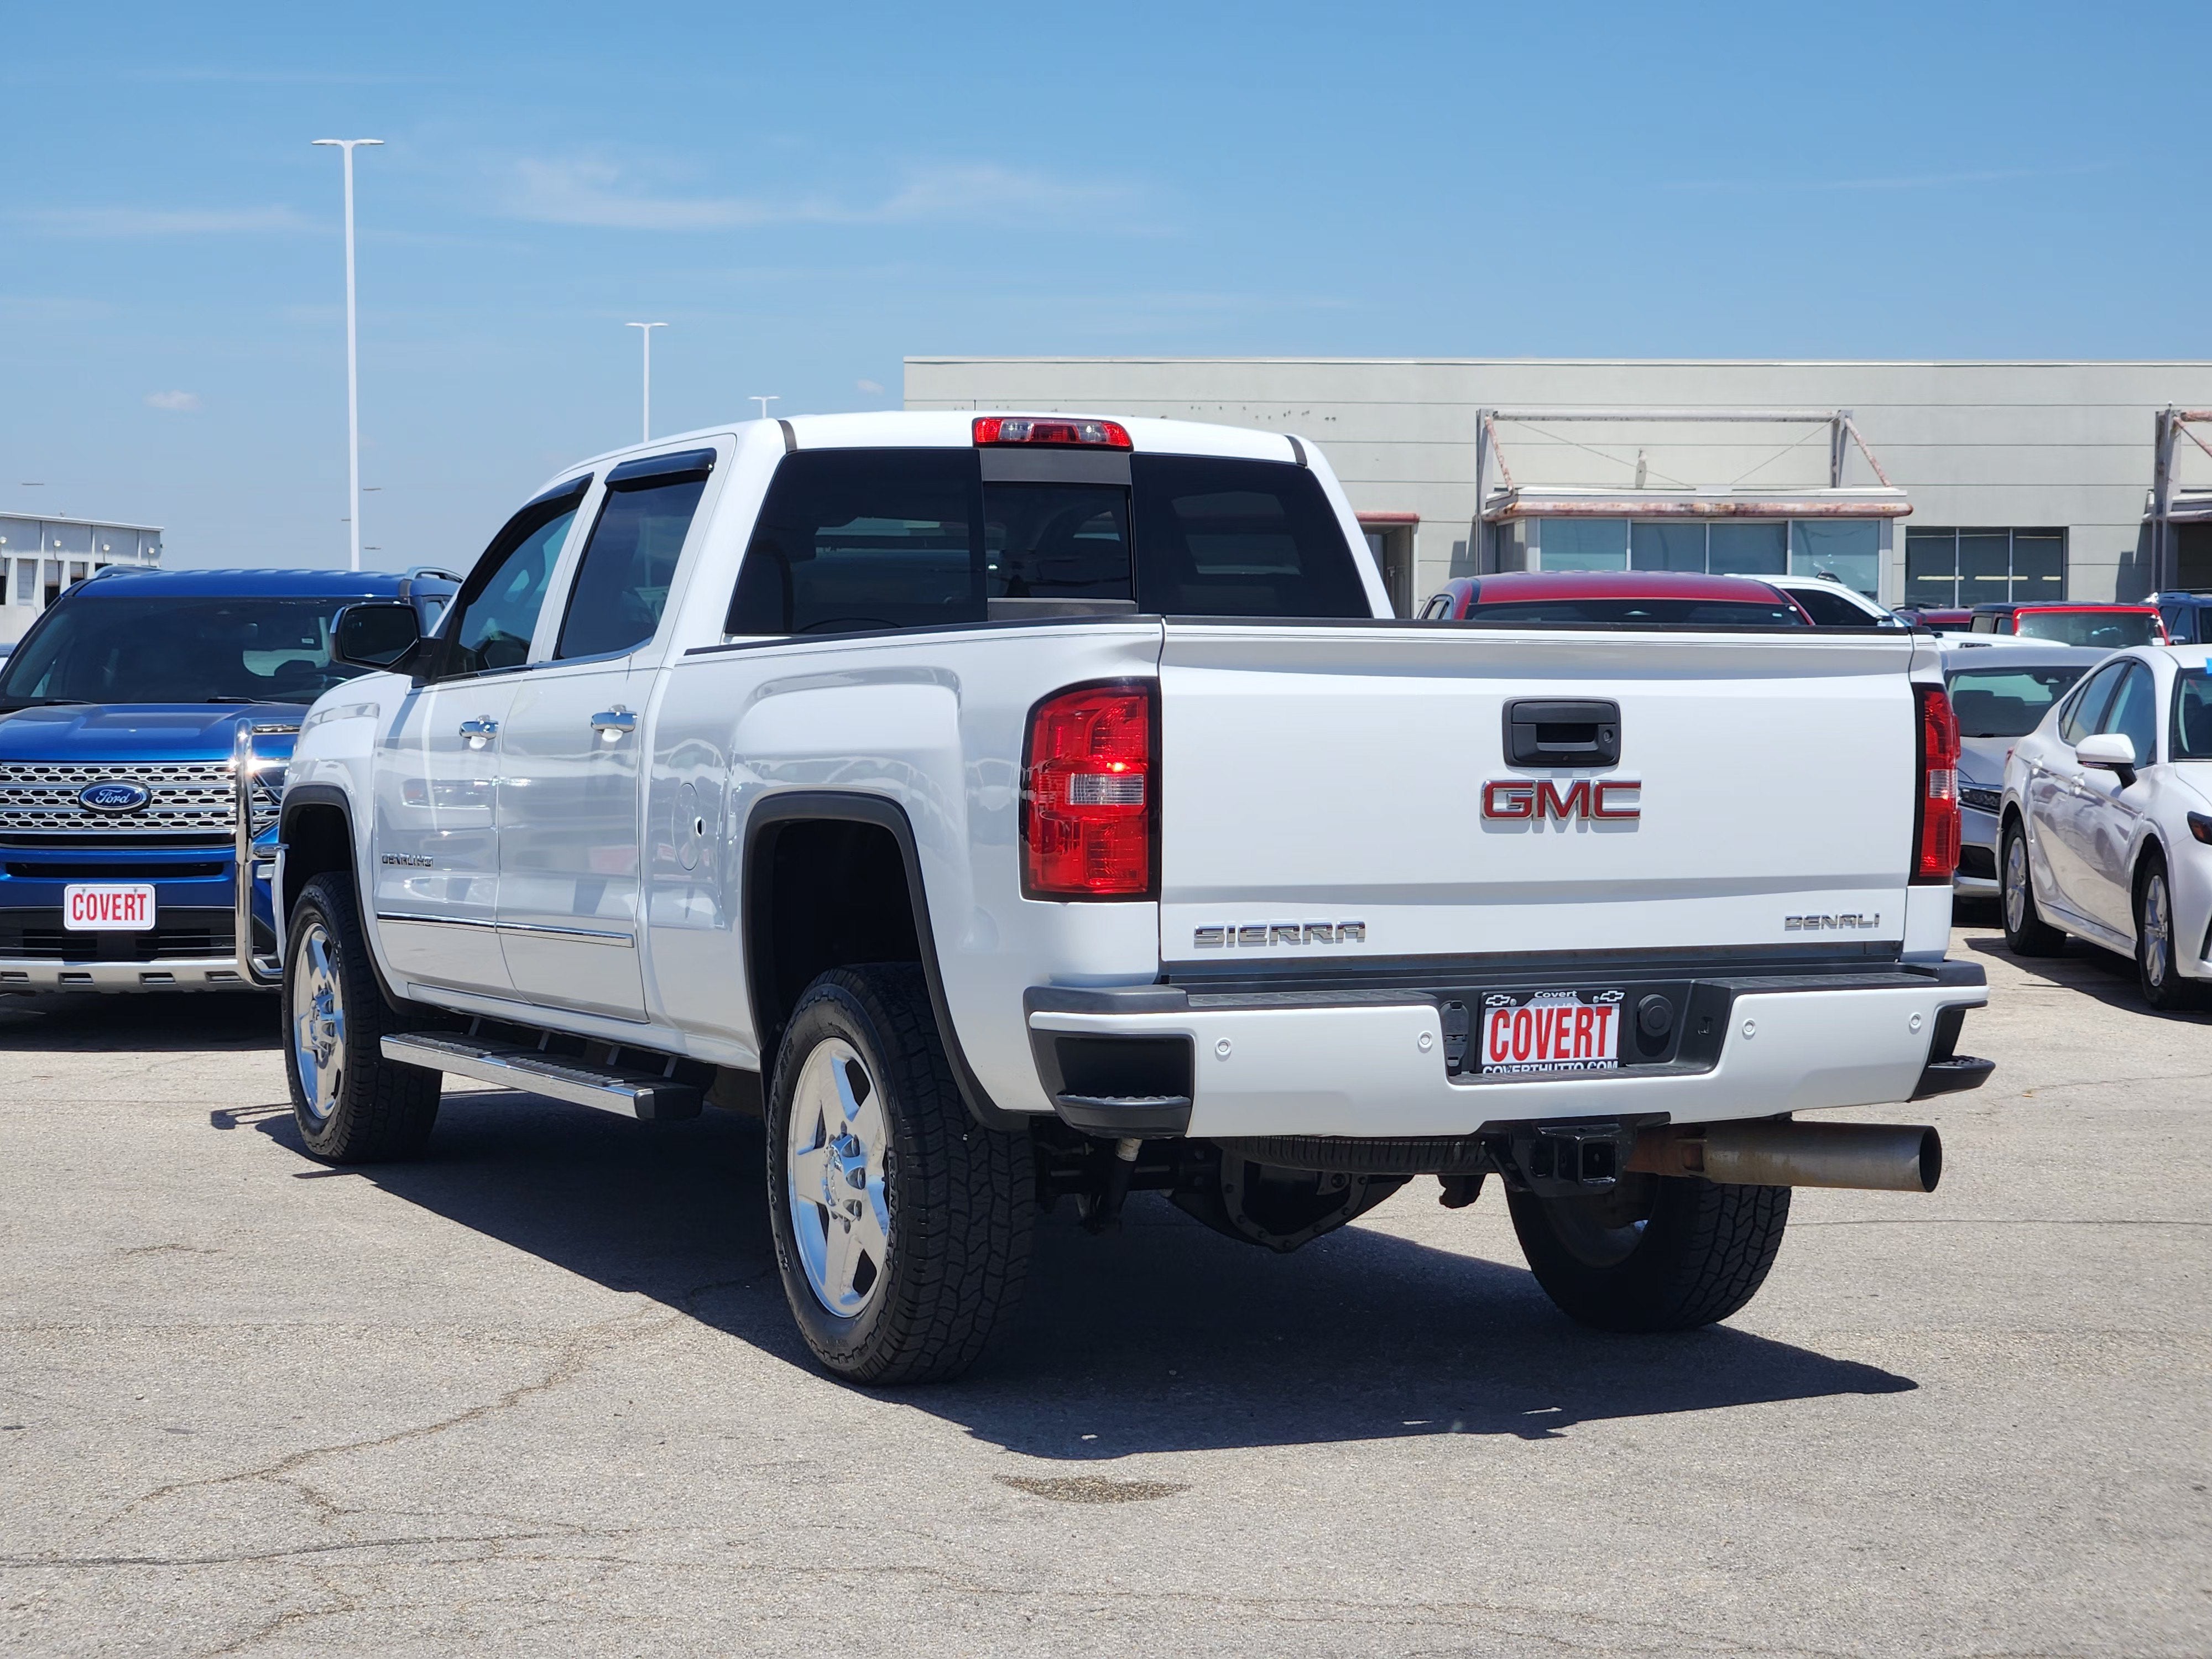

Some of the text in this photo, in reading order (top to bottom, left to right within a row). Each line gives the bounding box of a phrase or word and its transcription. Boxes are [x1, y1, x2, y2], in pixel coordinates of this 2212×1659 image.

[95, 789, 130, 804] Ford
[1480, 779, 1641, 821] GMC
[72, 893, 147, 921] COVERT
[1785, 913, 1880, 927] DENALI
[1194, 921, 1366, 944] SIERRA
[1534, 990, 1577, 999] Covert
[1490, 1005, 1613, 1062] COVERT
[1483, 1061, 1619, 1074] COVERTHUTTOCOM
